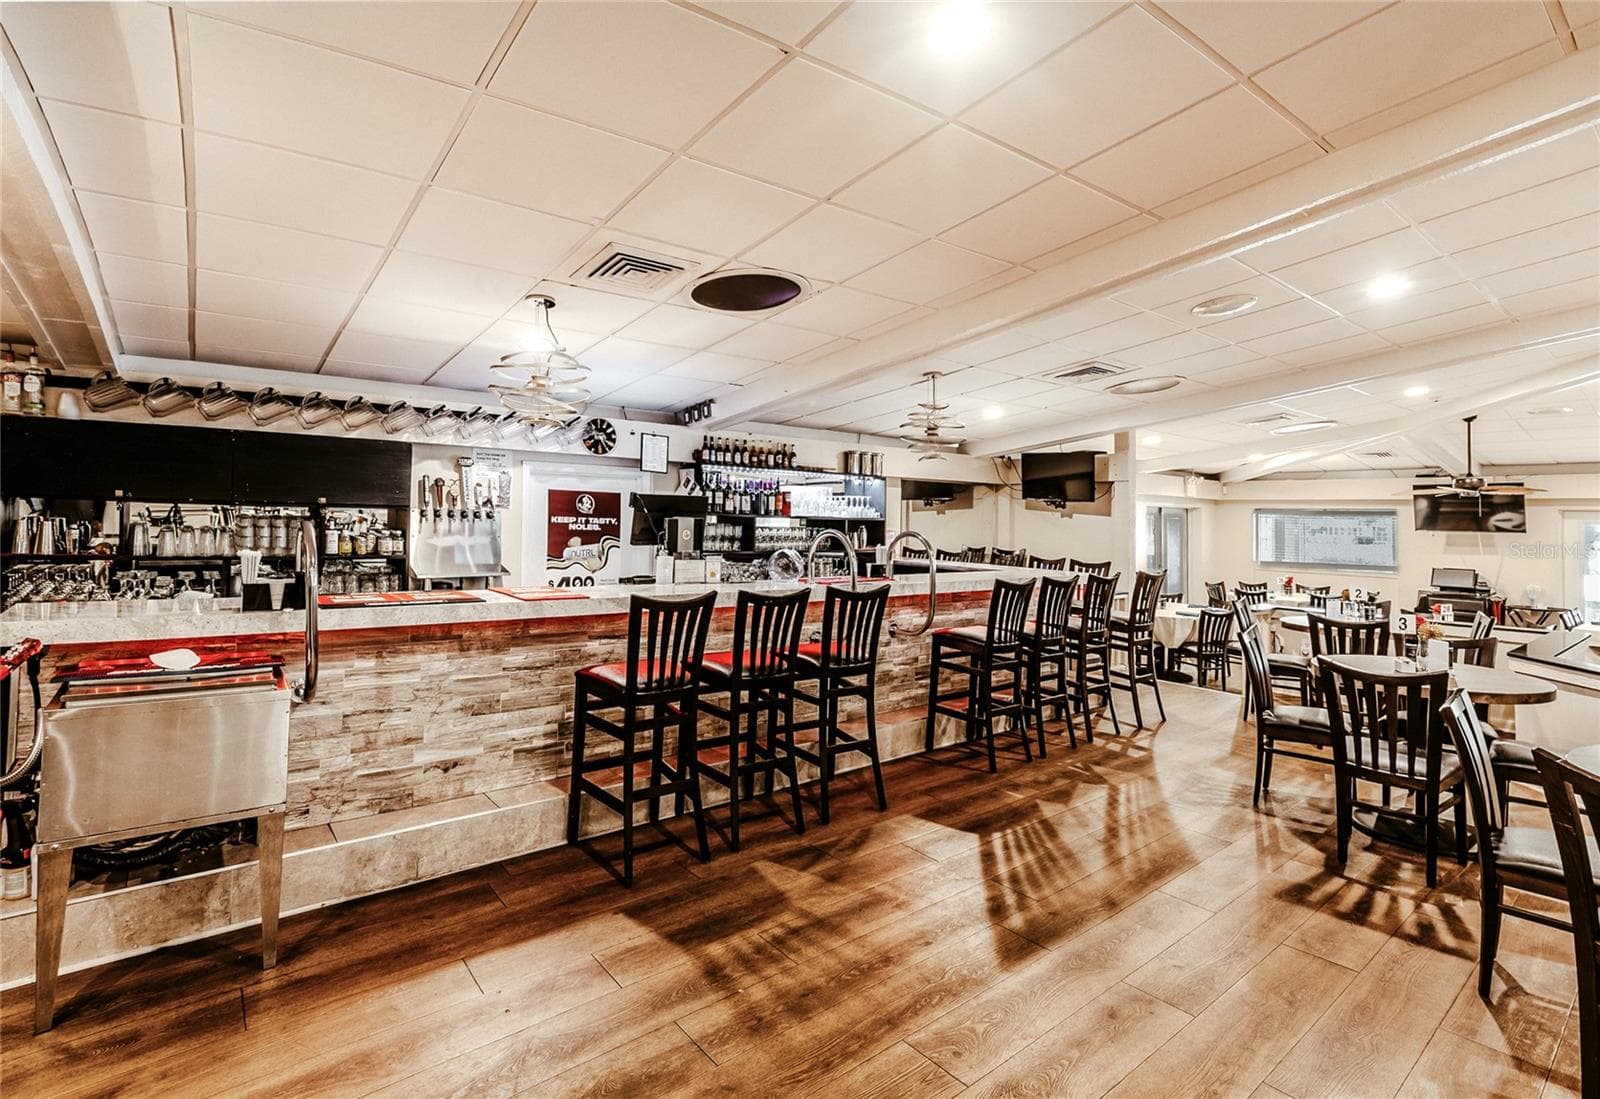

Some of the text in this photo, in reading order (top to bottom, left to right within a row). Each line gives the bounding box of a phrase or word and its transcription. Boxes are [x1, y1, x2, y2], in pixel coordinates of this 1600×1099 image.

[588, 517, 618, 525] TASTY,
[1355, 588, 1362, 599] 2
[1398, 617, 1408, 631] 3
